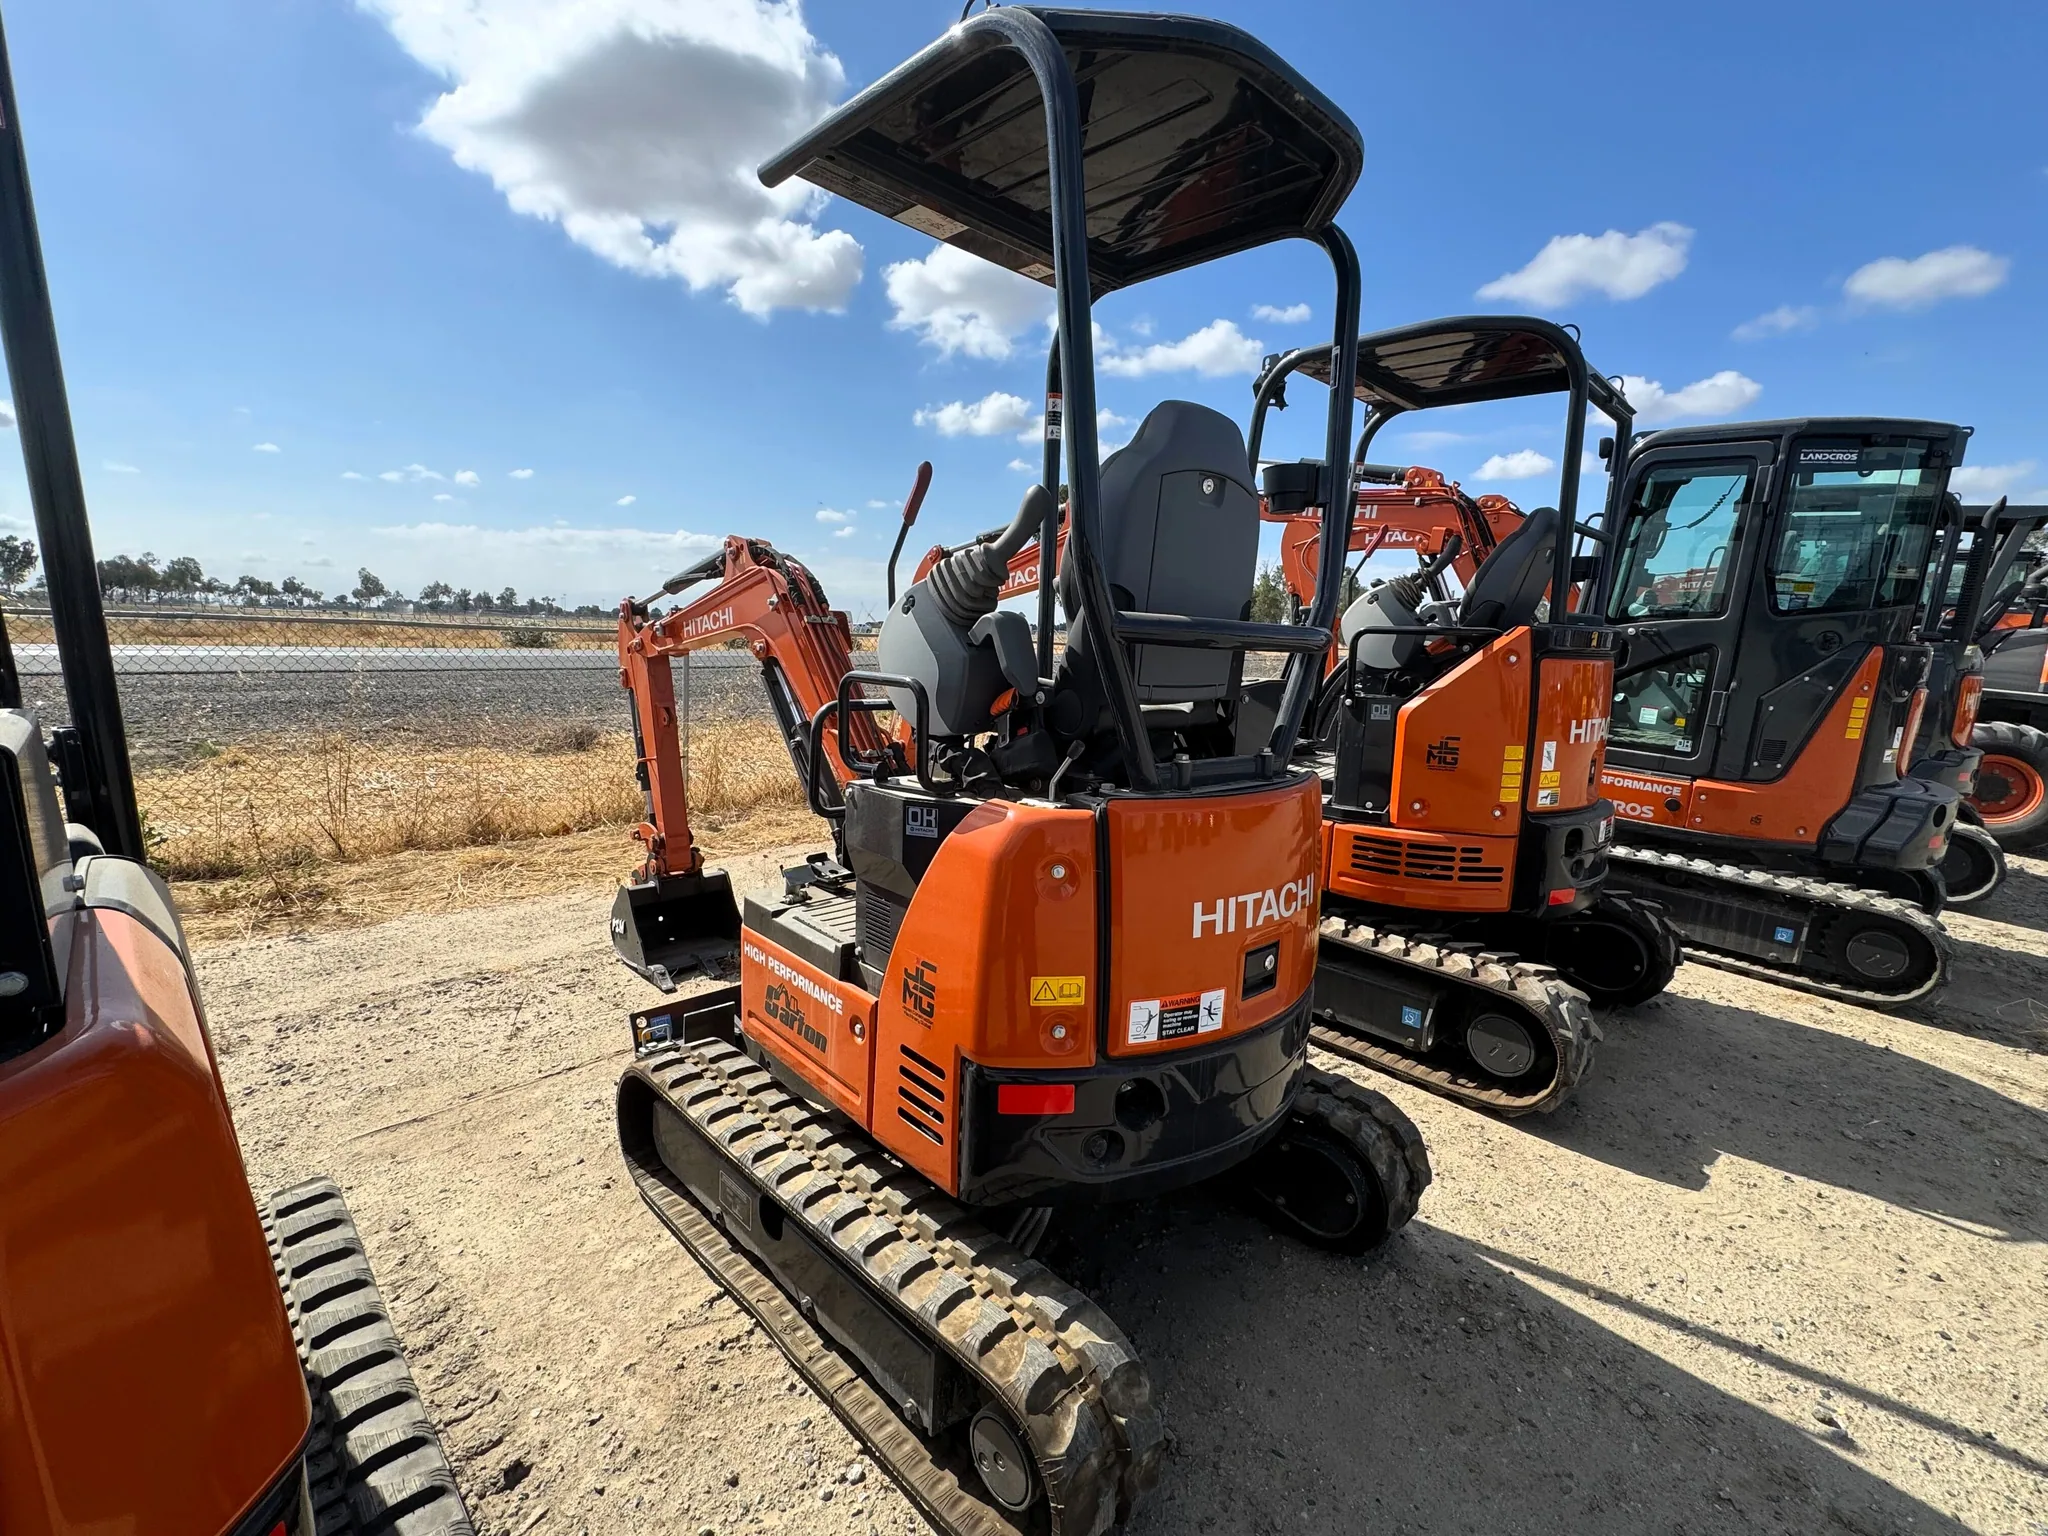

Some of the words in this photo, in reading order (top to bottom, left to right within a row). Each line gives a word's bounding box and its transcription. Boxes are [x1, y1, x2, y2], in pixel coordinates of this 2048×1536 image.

[683, 606, 733, 638] HITACHI
[1192, 872, 1314, 938] HITACHI
[744, 941, 766, 966] HIGH
[768, 956, 843, 1015] PERFORMANCE
[1168, 996, 1200, 1007] WARNING
[1177, 1026, 1195, 1034] CLEAR
